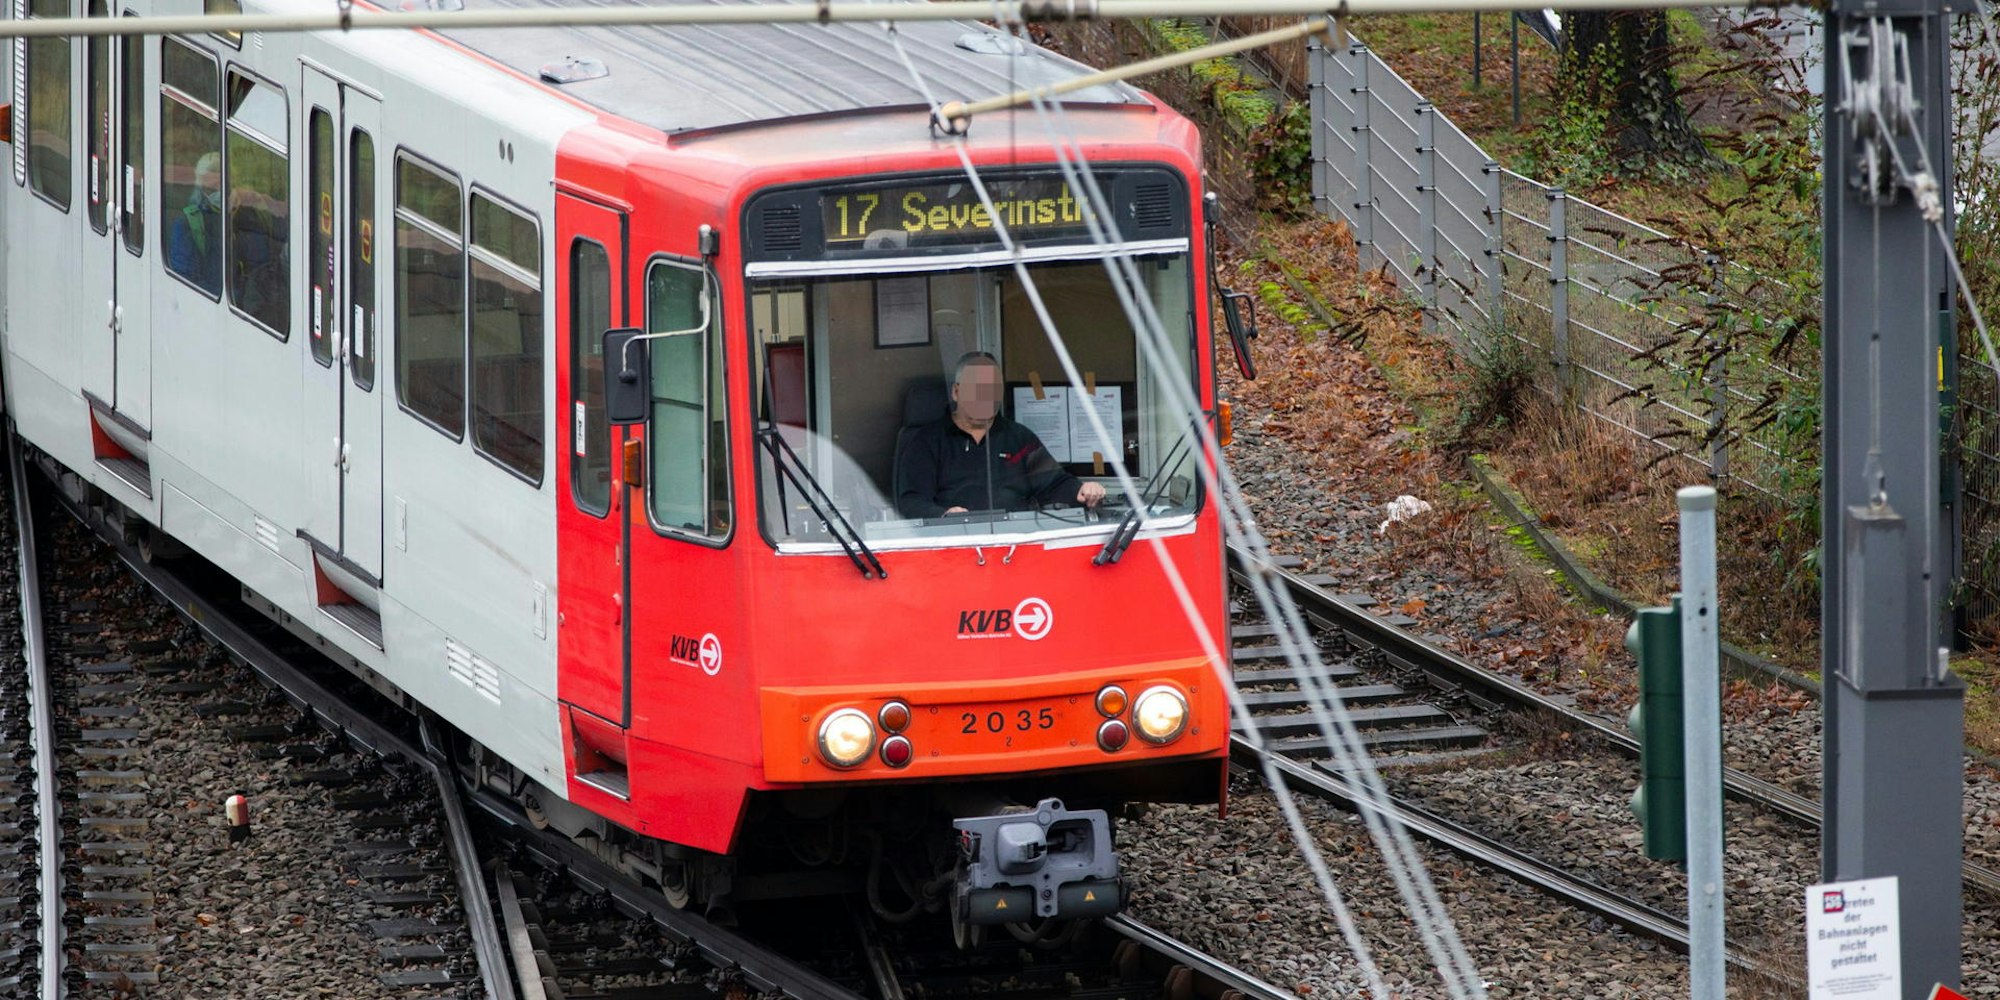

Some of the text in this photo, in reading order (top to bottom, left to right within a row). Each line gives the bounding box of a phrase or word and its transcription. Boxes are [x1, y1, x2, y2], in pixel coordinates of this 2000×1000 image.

[836, 194, 879, 236] 17
[958, 609, 1012, 633] KVB
[671, 634, 700, 661] KVB
[962, 708, 1054, 734] 2035
[1845, 897, 1875, 909] treten
[1844, 912, 1862, 923] der
[1818, 925, 1888, 940] Bahnanlagen
[1840, 940, 1867, 952] nicht
[1831, 953, 1877, 969] gestattet
